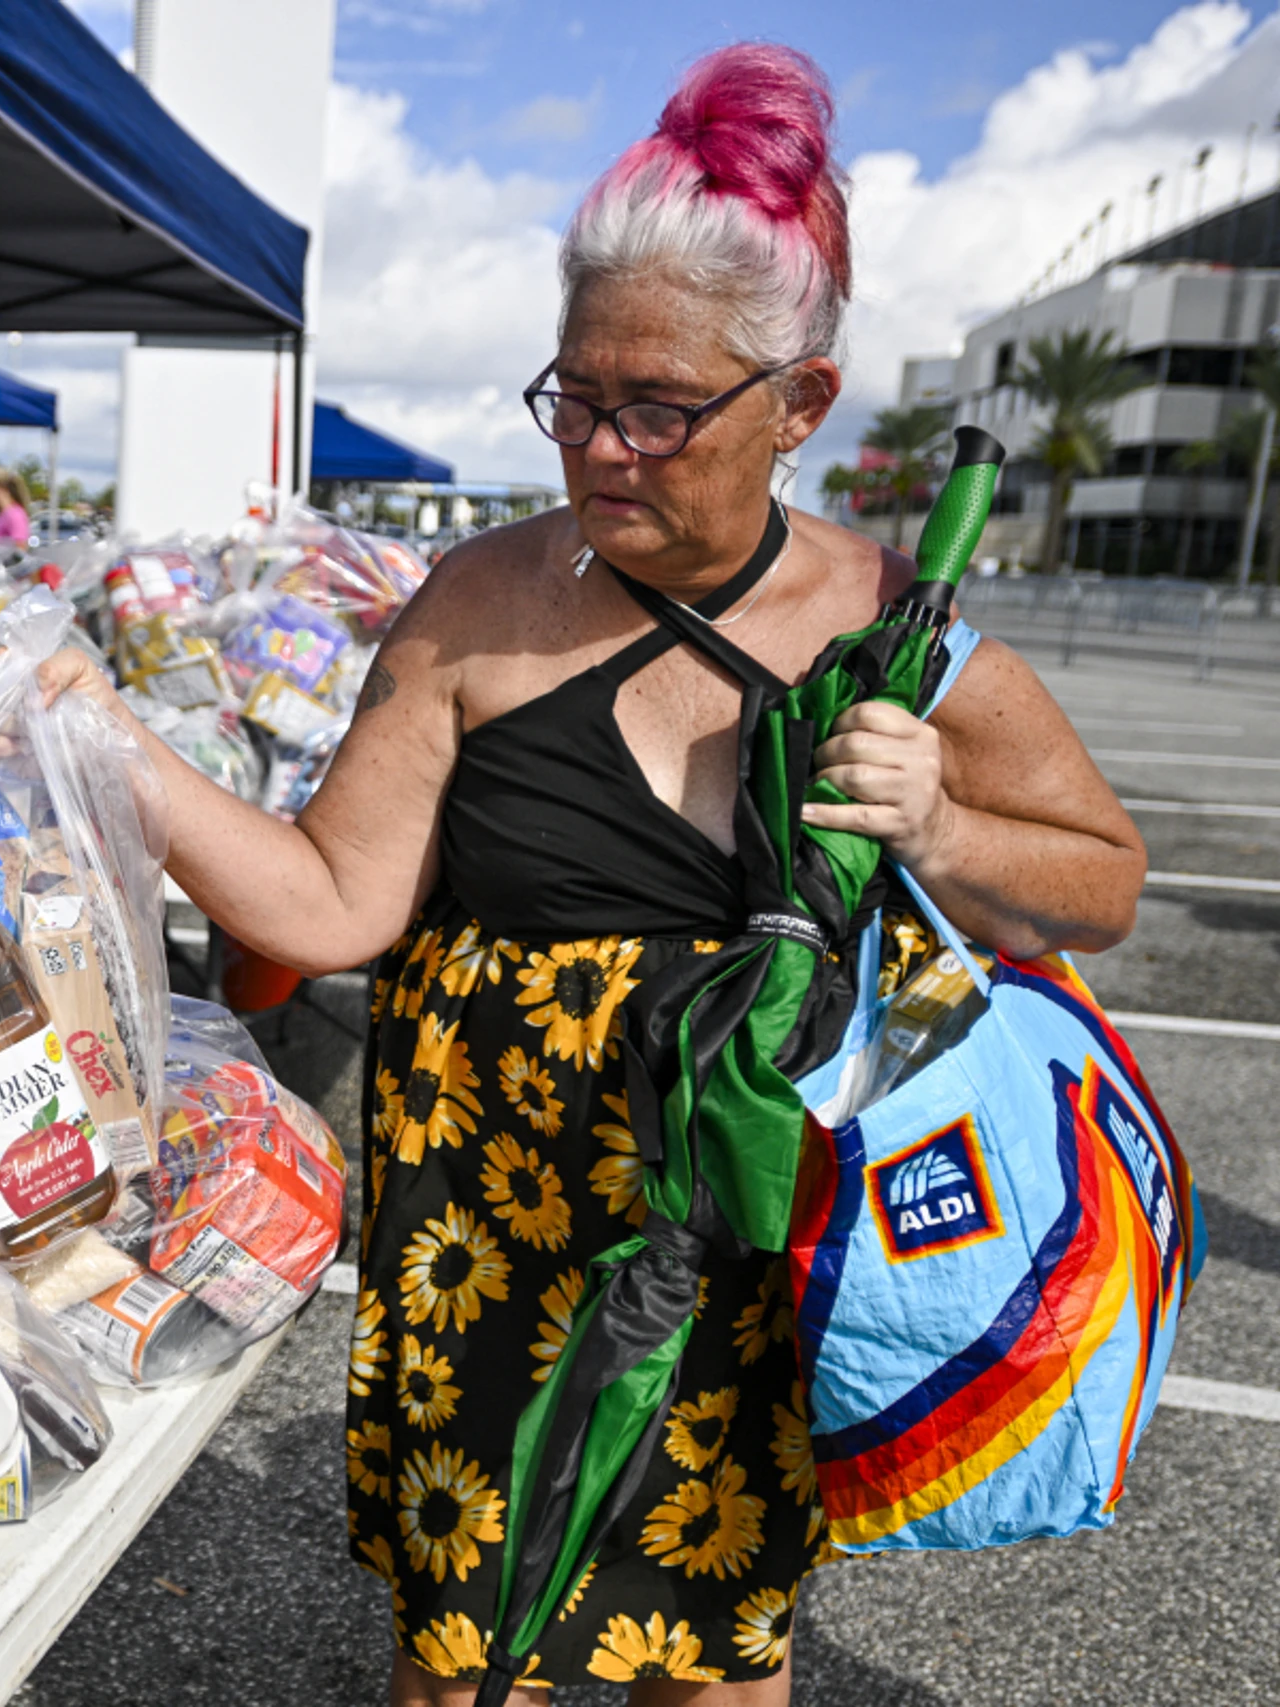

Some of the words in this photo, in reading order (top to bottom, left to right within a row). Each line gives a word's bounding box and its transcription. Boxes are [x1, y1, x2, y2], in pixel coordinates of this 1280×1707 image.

[66, 1030, 116, 1099] Chex
[13, 1145, 45, 1186] Apple
[47, 1130, 80, 1162] Cider
[899, 1191, 977, 1234] ALDI
